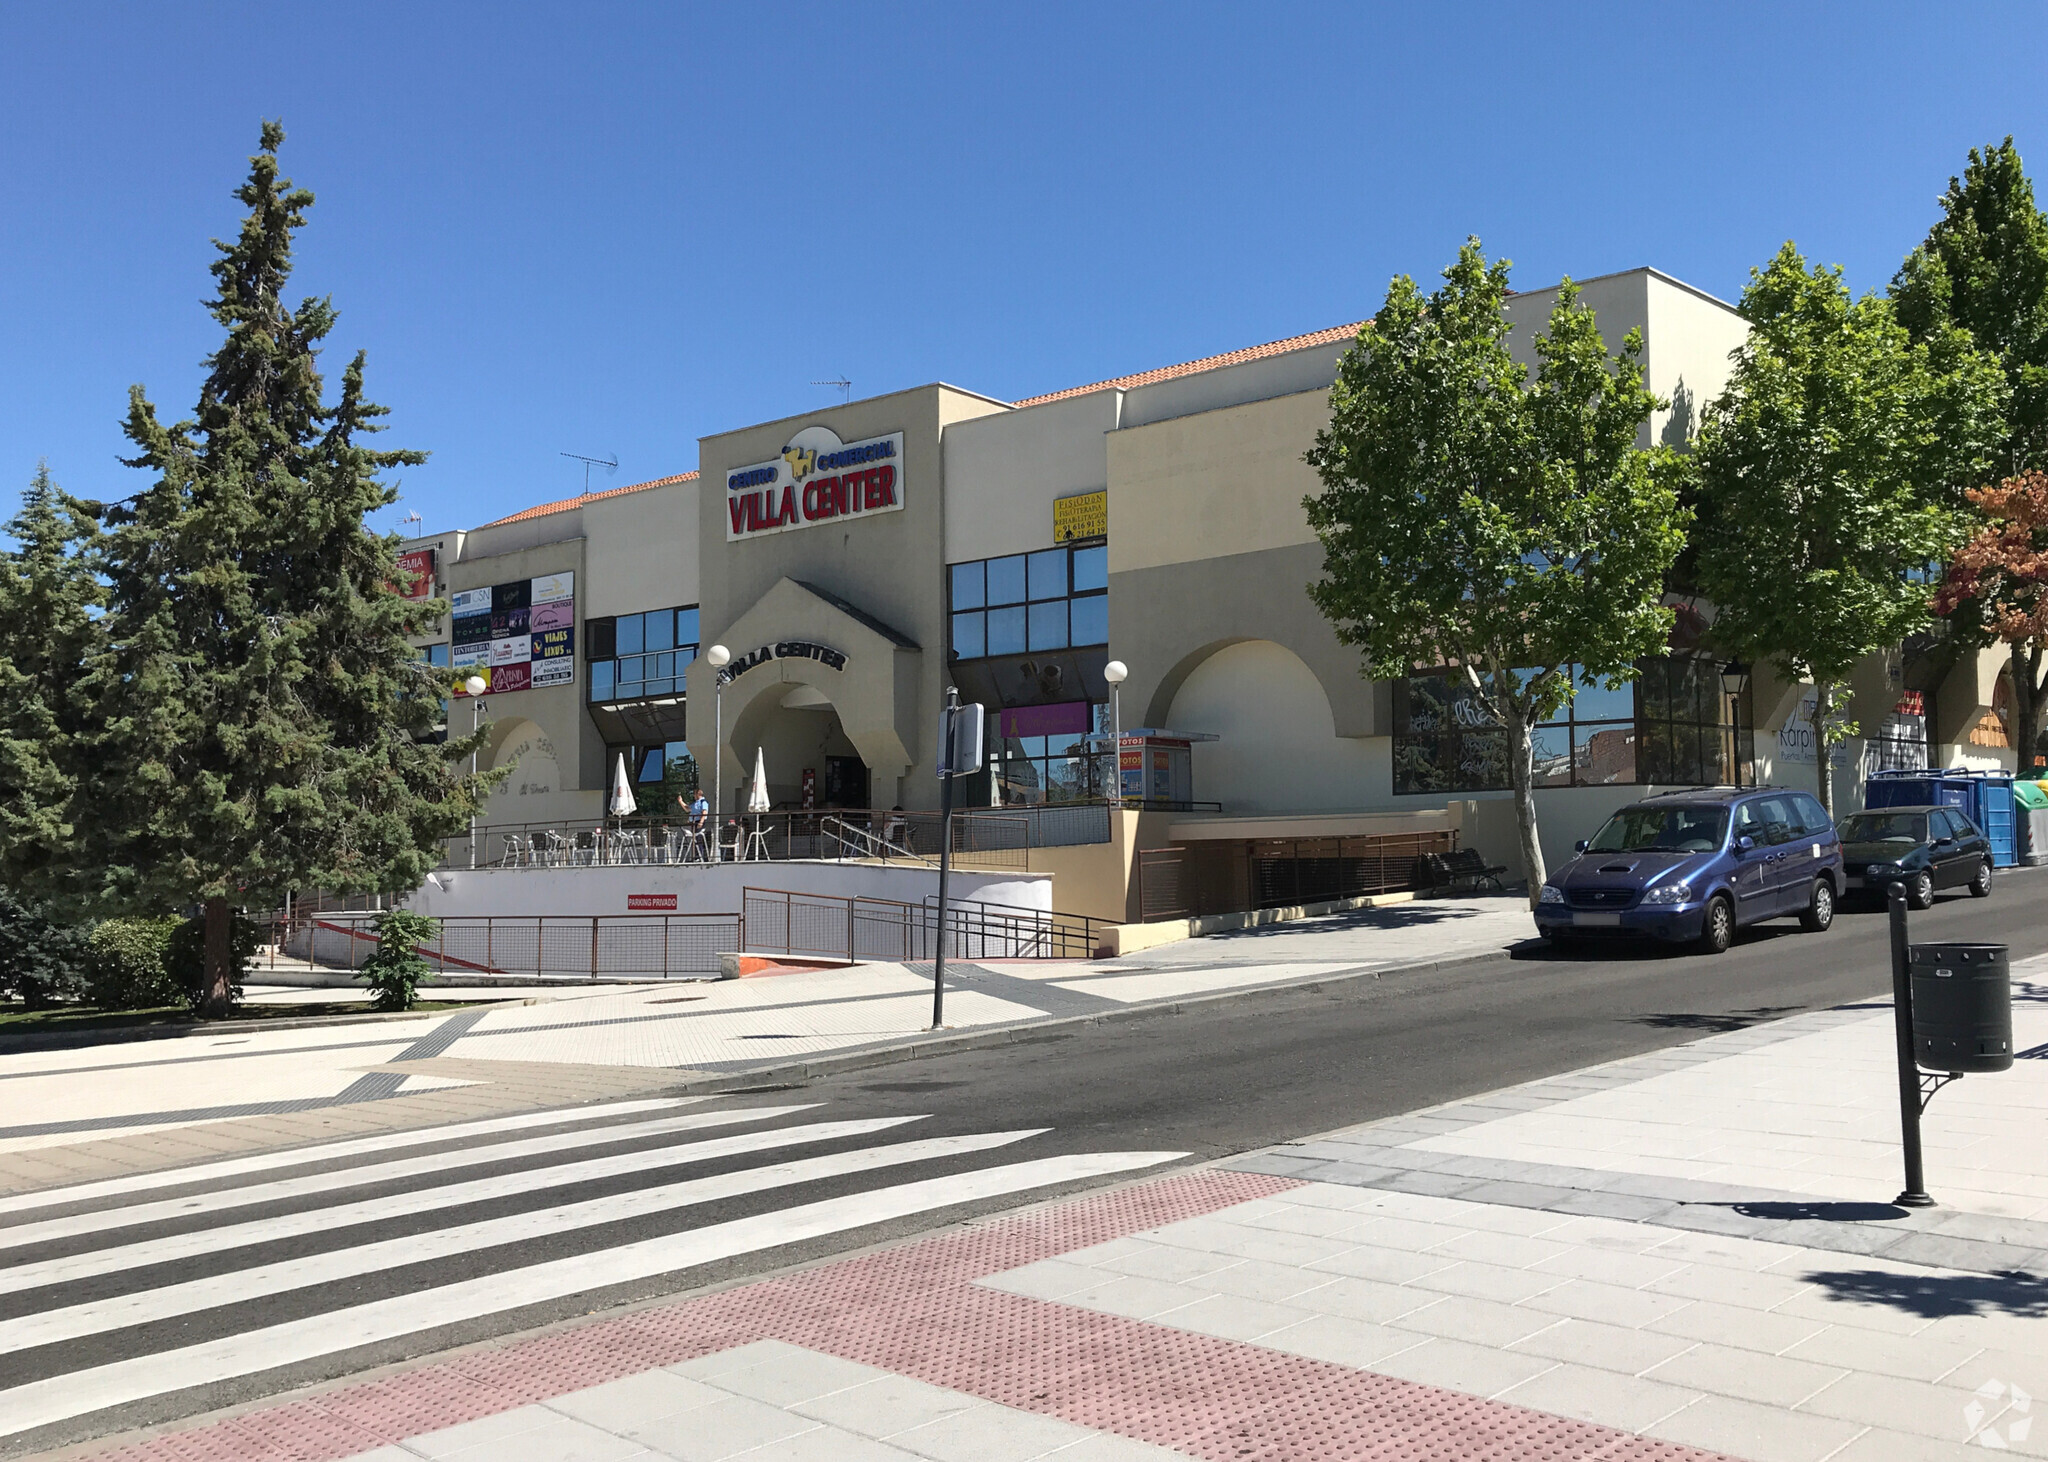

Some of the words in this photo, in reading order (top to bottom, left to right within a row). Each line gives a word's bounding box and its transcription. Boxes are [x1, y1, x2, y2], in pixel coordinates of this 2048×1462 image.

[729, 467, 777, 491] CENTRO
[817, 441, 895, 471] COMERCIAL
[729, 486, 799, 535] VILLA
[803, 465, 897, 521] CENTER
[545, 631, 568, 643] VIAJES
[544, 658, 572, 666] CONSULTING
[775, 643, 846, 671] CENTER
[628, 898, 652, 906] PARKING
[652, 898, 677, 906] PRIVADO
